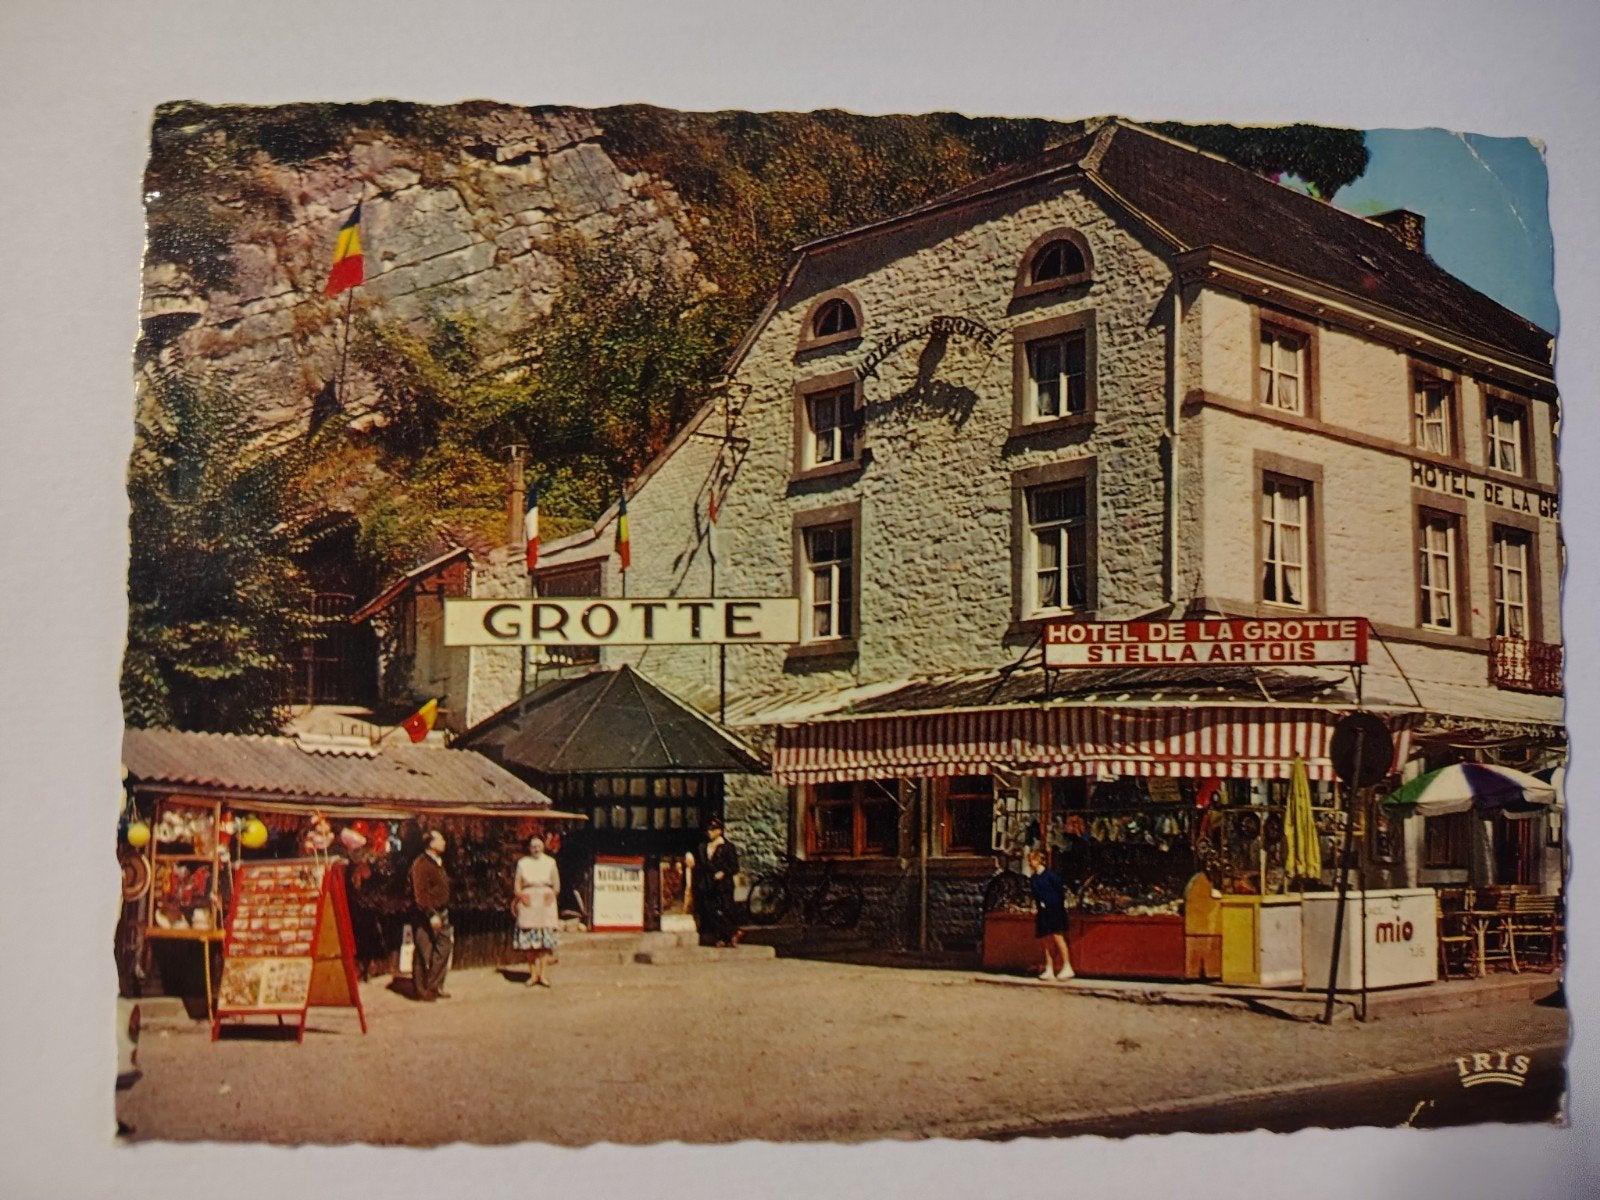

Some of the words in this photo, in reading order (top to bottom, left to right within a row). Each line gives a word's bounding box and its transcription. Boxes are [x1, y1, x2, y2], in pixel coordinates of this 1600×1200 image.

[1411, 461, 1475, 498] HOTEL
[1484, 482, 1504, 505] DE
[1511, 487, 1530, 512] LA
[483, 602, 762, 640] GROTTE
[1049, 624, 1140, 643] HOTEL
[1149, 623, 1186, 642] DE
[1200, 622, 1234, 641] LA
[1242, 620, 1357, 641] GROTTE
[1088, 644, 1198, 662] STELLA
[1207, 642, 1316, 662] ARTOIS
[1376, 915, 1413, 943] mio
